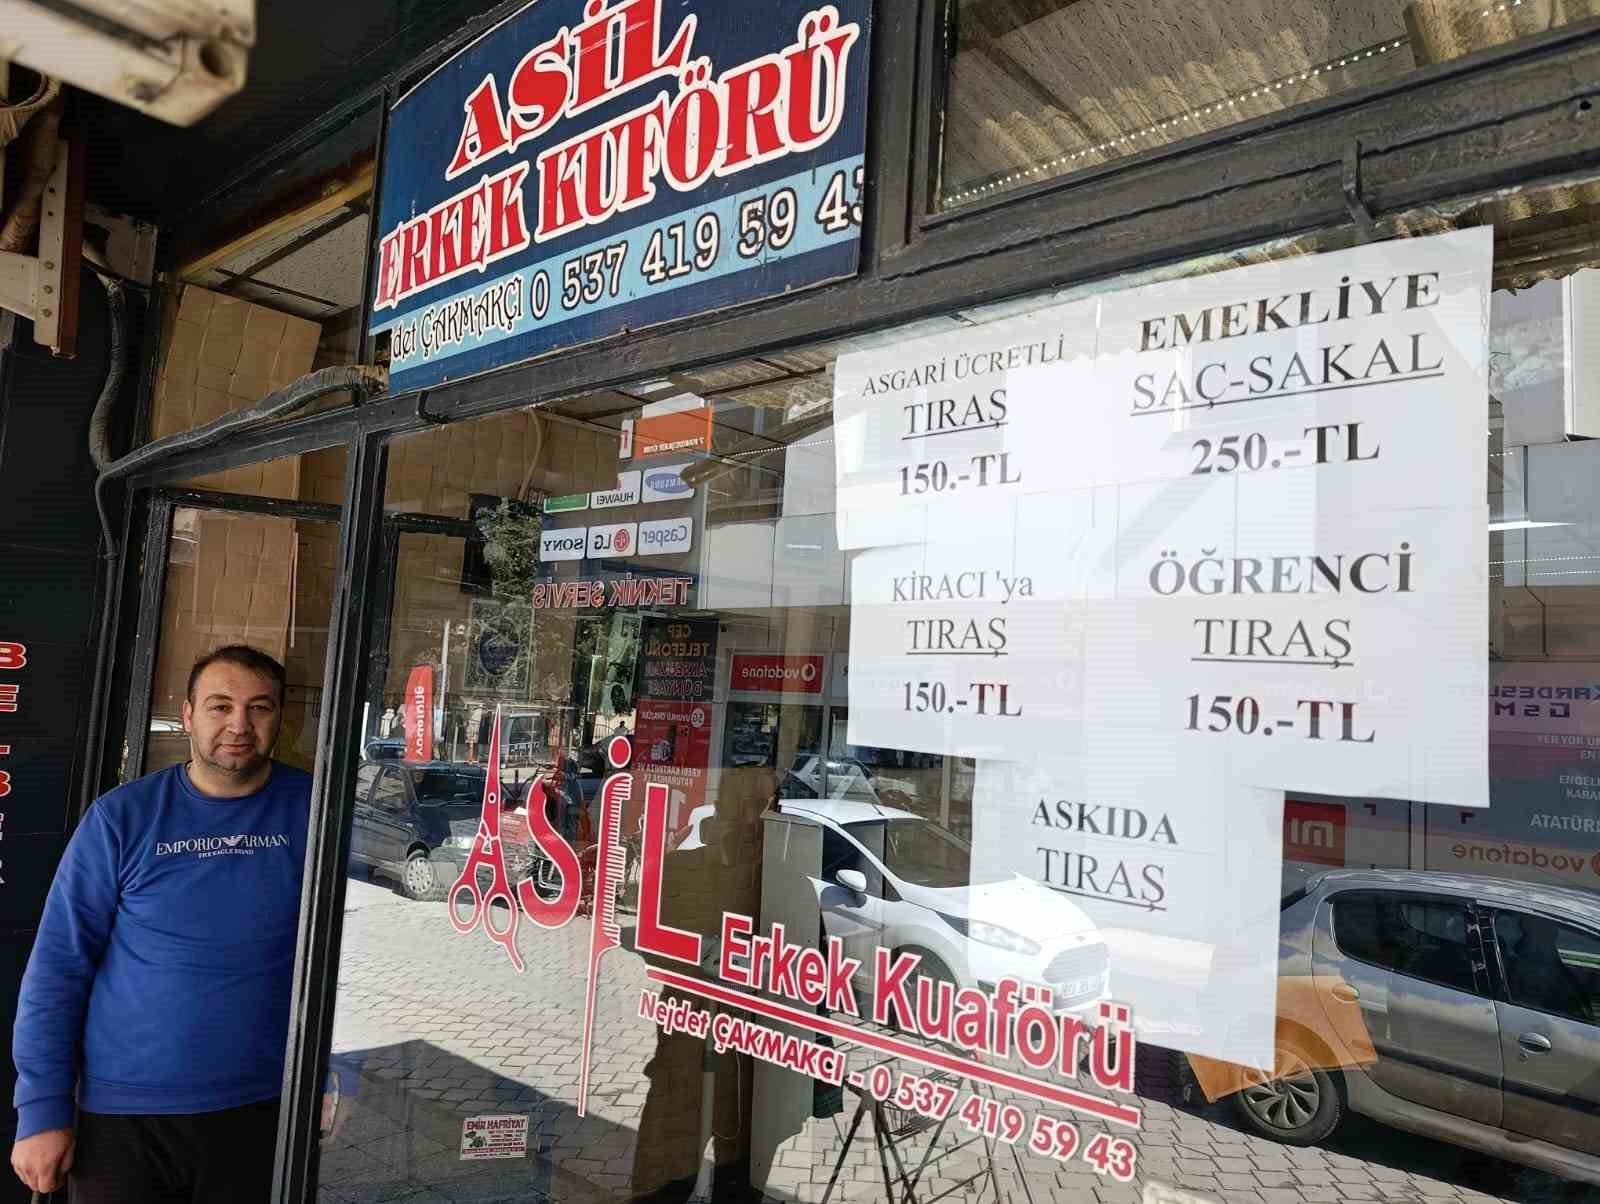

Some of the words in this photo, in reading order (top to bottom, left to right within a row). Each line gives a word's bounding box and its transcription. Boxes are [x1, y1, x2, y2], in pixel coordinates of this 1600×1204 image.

[446, 0, 698, 181] ASİL
[374, 161, 530, 310] ERKEK
[535, 5, 860, 245] KUFÖRÜ
[530, 269, 550, 321] 0
[560, 240, 629, 312] 537
[640, 213, 721, 284] 419
[737, 186, 798, 257] 59
[1137, 271, 1442, 354] EMEKLİYE
[862, 358, 948, 397] ASGARİ
[953, 333, 1066, 383] ÜCRETLİ
[1132, 333, 1444, 412] SAÇ-SAKAL
[904, 389, 1008, 435] TIRAŞ
[899, 452, 1022, 496] 150.-TL
[1192, 421, 1381, 476] 250.-TL
[892, 570, 986, 602] KİRACI
[1149, 542, 1414, 595] ÖĞRENCİ
[906, 617, 1009, 655] TIRAŞ
[1193, 618, 1352, 667] TIRAŞ
[903, 681, 1023, 717] 150.-TL
[1184, 693, 1376, 743] 150.-TL
[156, 837, 222, 856] EMPORIO
[1031, 799, 1179, 845] ASKIDA
[1036, 846, 1167, 910] TIRAŞ
[718, 911, 862, 1015] Erkek
[873, 946, 1137, 1093] Kuaförü
[638, 990, 710, 1039] Nejdet
[713, 1012, 846, 1086] ÇAKMAKCI
[869, 1066, 893, 1100] 0
[896, 1074, 957, 1121] 537
[960, 1096, 1025, 1147] 419
[1030, 1114, 1080, 1163] 59
[1083, 1134, 1137, 1182] 43
